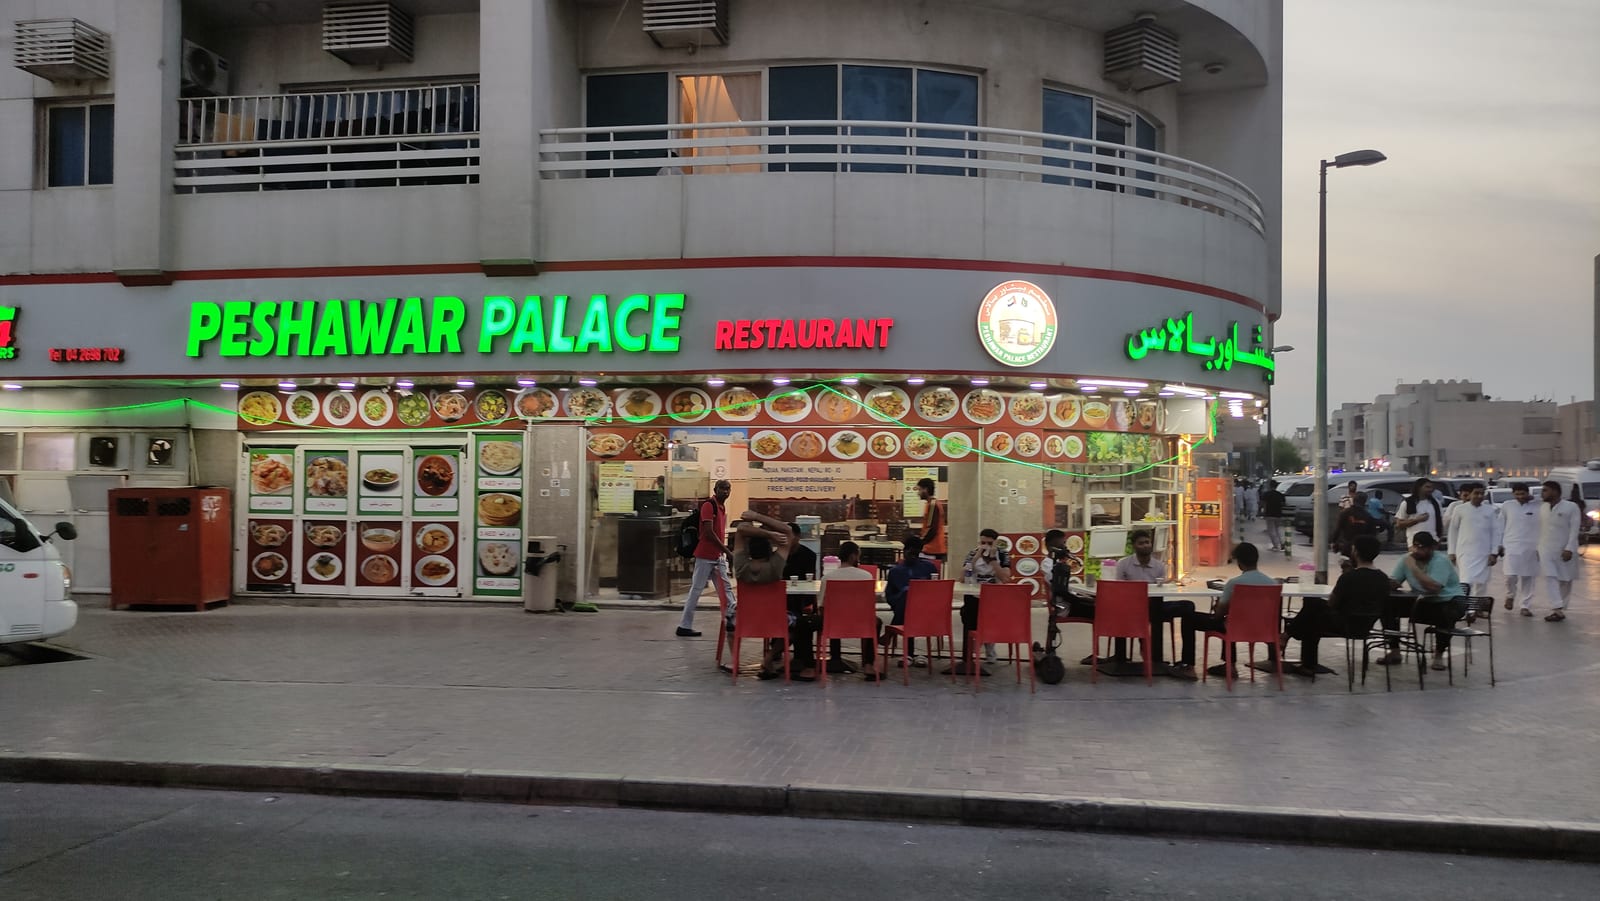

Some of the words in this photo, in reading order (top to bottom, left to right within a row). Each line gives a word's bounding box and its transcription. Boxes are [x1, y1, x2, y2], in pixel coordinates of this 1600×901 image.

[186, 296, 466, 357] PESHAWAR
[478, 293, 685, 353] PALACE
[715, 318, 894, 350] RESTAURANT
[65, 347, 78, 361] 04
